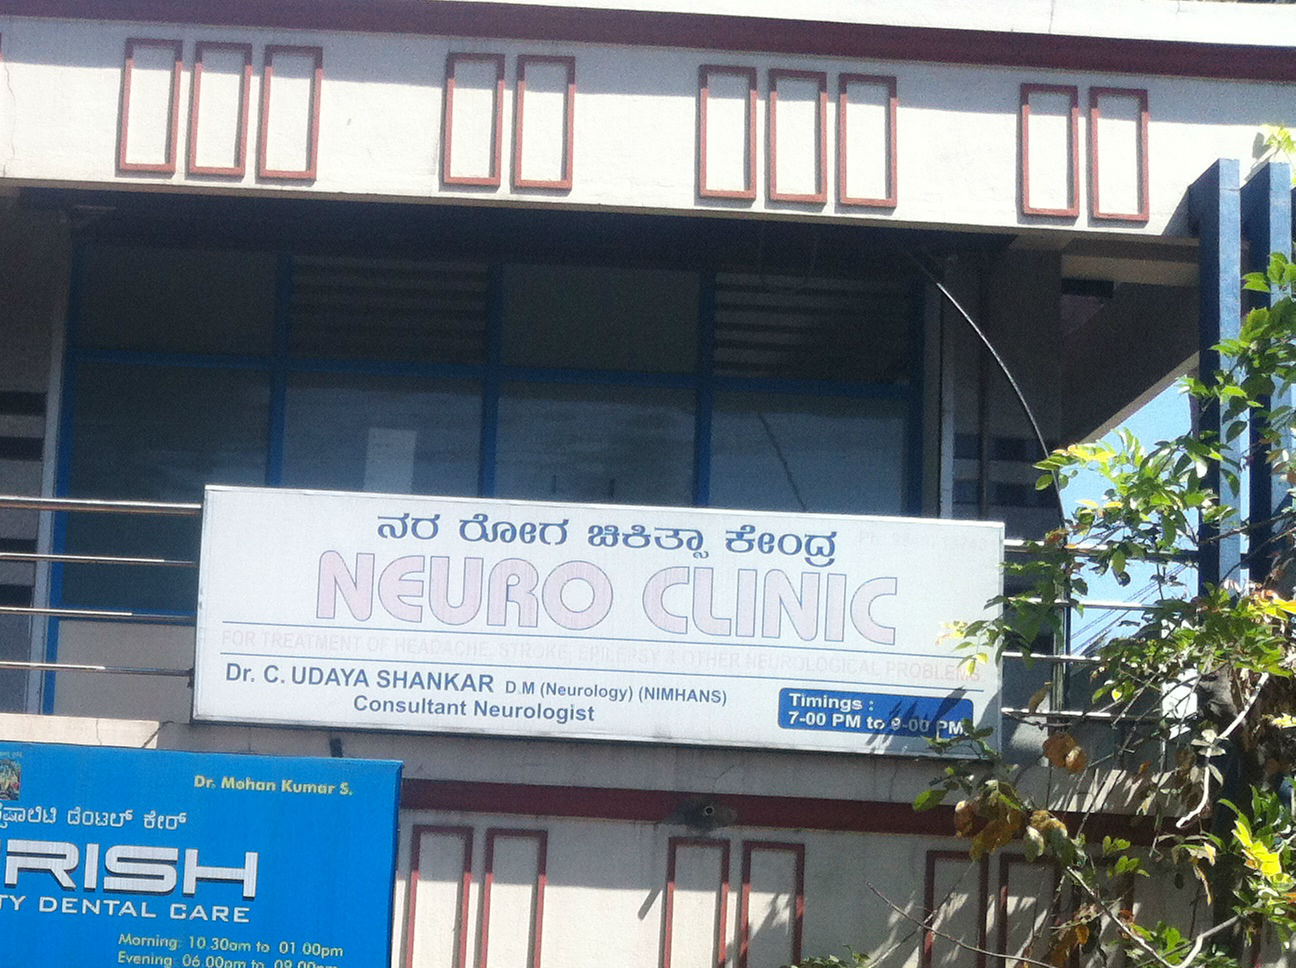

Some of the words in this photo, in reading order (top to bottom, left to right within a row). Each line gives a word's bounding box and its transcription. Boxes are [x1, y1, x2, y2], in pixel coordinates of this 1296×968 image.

[377, 513, 441, 541] ನರ
[459, 513, 569, 546] ರೋಗ
[725, 524, 838, 568] ಕೇಂದ್ರ
[316, 549, 613, 631] NEURO
[642, 565, 898, 647] CLINIC
[221, 629, 256, 647] FOR
[261, 630, 363, 652] TREATMENT
[367, 636, 390, 652] OF
[682, 650, 740, 669] OTHER
[225, 663, 255, 683] Dr.
[264, 664, 285, 684] C.
[291, 666, 370, 688] UDAYA
[376, 669, 494, 693] SHANKAR
[540, 681, 633, 702] (Neurology)
[639, 686, 728, 707] (NIMHANS)
[353, 695, 467, 717] Consultant
[473, 700, 595, 725] Neurologist
[788, 692, 863, 713] Timings
[788, 711, 826, 727] 7-00
[832, 712, 861, 729] PM
[866, 715, 886, 730] to
[890, 716, 930, 733] 9-00
[936, 720, 963, 736] PM
[193, 774, 217, 789] Dr.
[221, 776, 277, 792] Mohan
[281, 778, 336, 795] Kumar
[339, 781, 353, 796] S.
[66, 806, 134, 828] ಡೆಂಟಲ್
[38, 895, 158, 920] DENTAL
[169, 903, 251, 924] CARE
[256, 940, 270, 953] to
